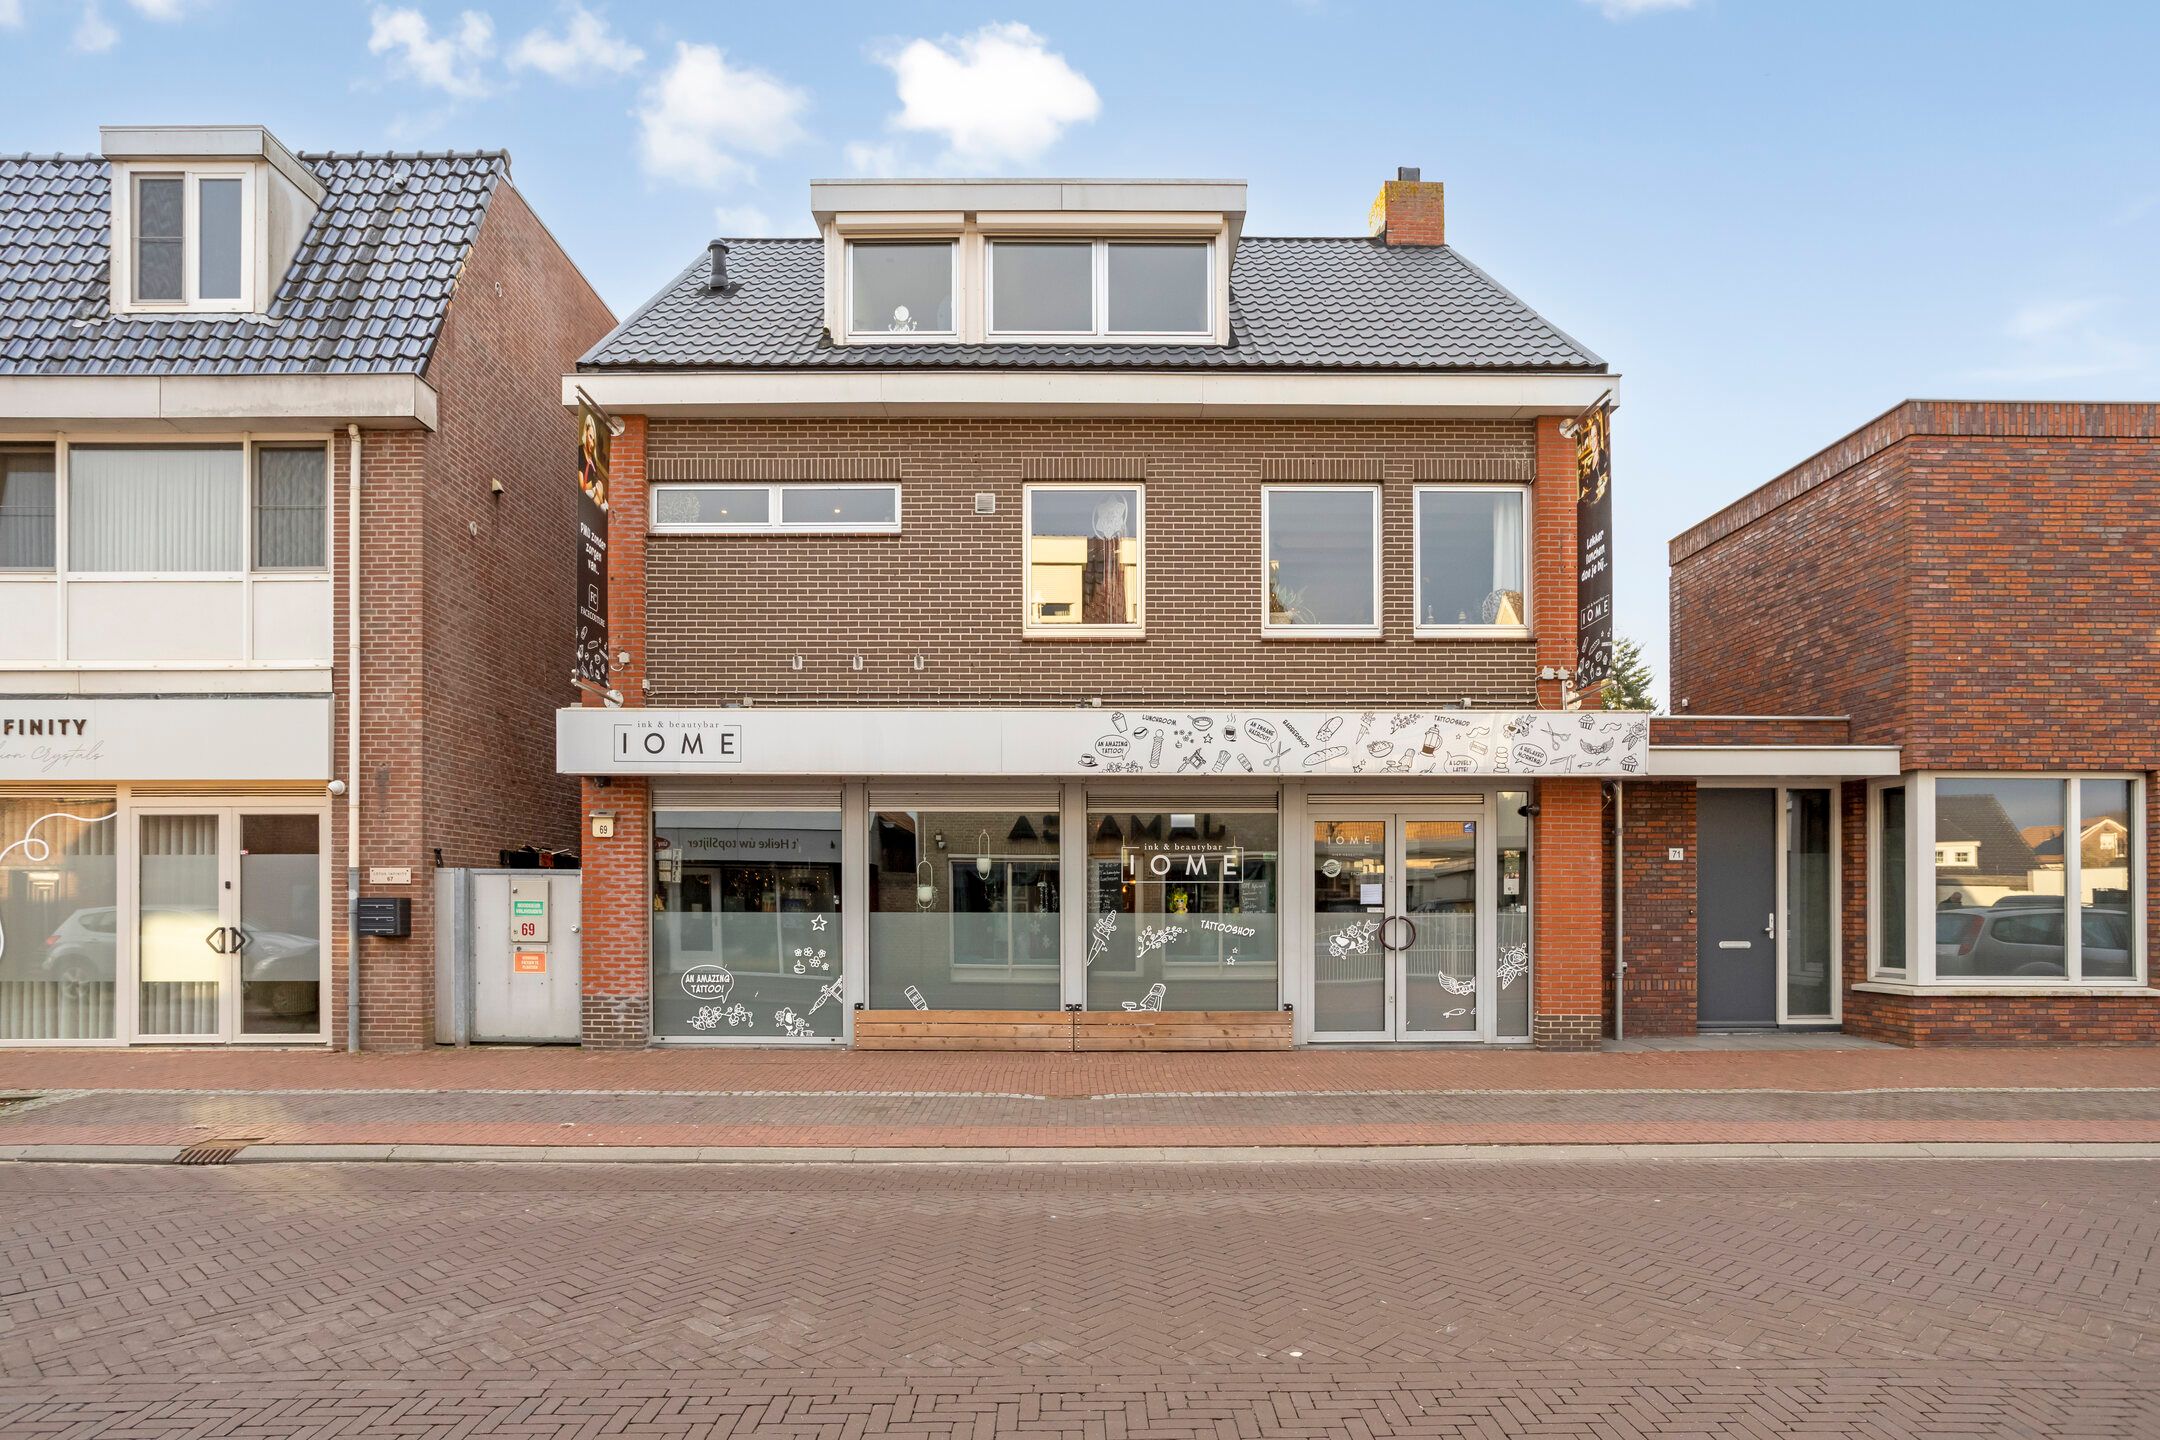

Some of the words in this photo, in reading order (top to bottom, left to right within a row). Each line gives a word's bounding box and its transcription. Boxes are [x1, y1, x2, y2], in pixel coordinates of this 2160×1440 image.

[1582, 599, 1609, 625] IOME
[669, 721, 720, 730] beautybar
[1142, 714, 1177, 726] LUNCHROOM
[1434, 715, 1471, 727] TATTOOSHOP
[1282, 719, 1310, 748] BARBERSHOP
[623, 732, 735, 755] IOME
[31, 739, 105, 773] Crystals
[599, 825, 608, 834] 69
[1327, 835, 1371, 845] IOME
[1174, 843, 1223, 852] beautybar
[1672, 850, 1681, 858] 71
[1130, 854, 1237, 875] IOME
[521, 923, 535, 936] 69
[1200, 919, 1256, 938] TATTOOSHOP
[685, 974, 695, 983] AN
[696, 974, 730, 983] AMAZING
[690, 984, 725, 993] TATTOO!
